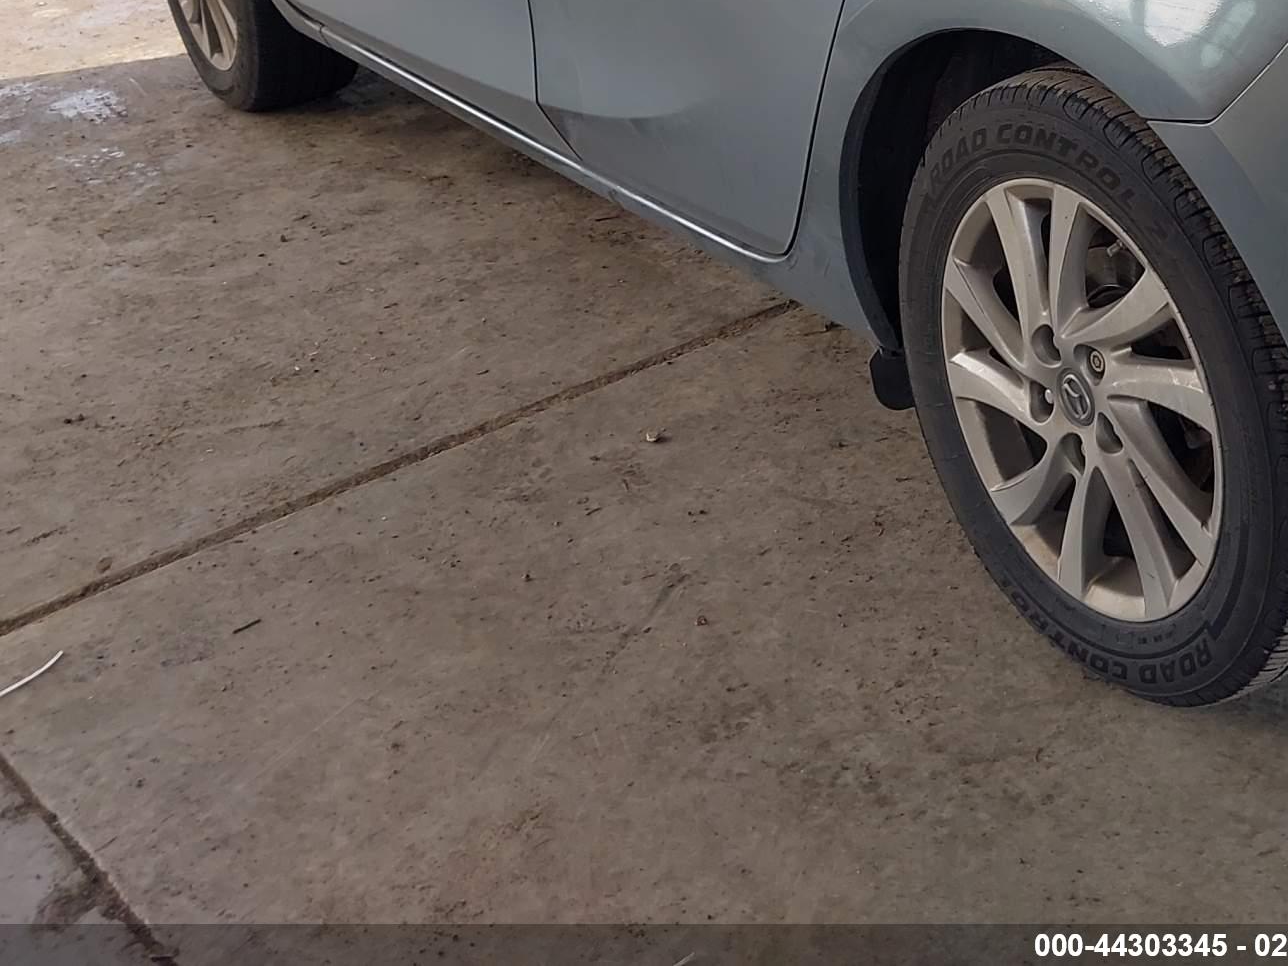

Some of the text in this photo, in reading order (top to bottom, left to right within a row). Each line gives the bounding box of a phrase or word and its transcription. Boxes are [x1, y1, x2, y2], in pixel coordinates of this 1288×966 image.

[929, 122, 1141, 211] ROAD CONTROL
[1137, 636, 1214, 685] ROAD
